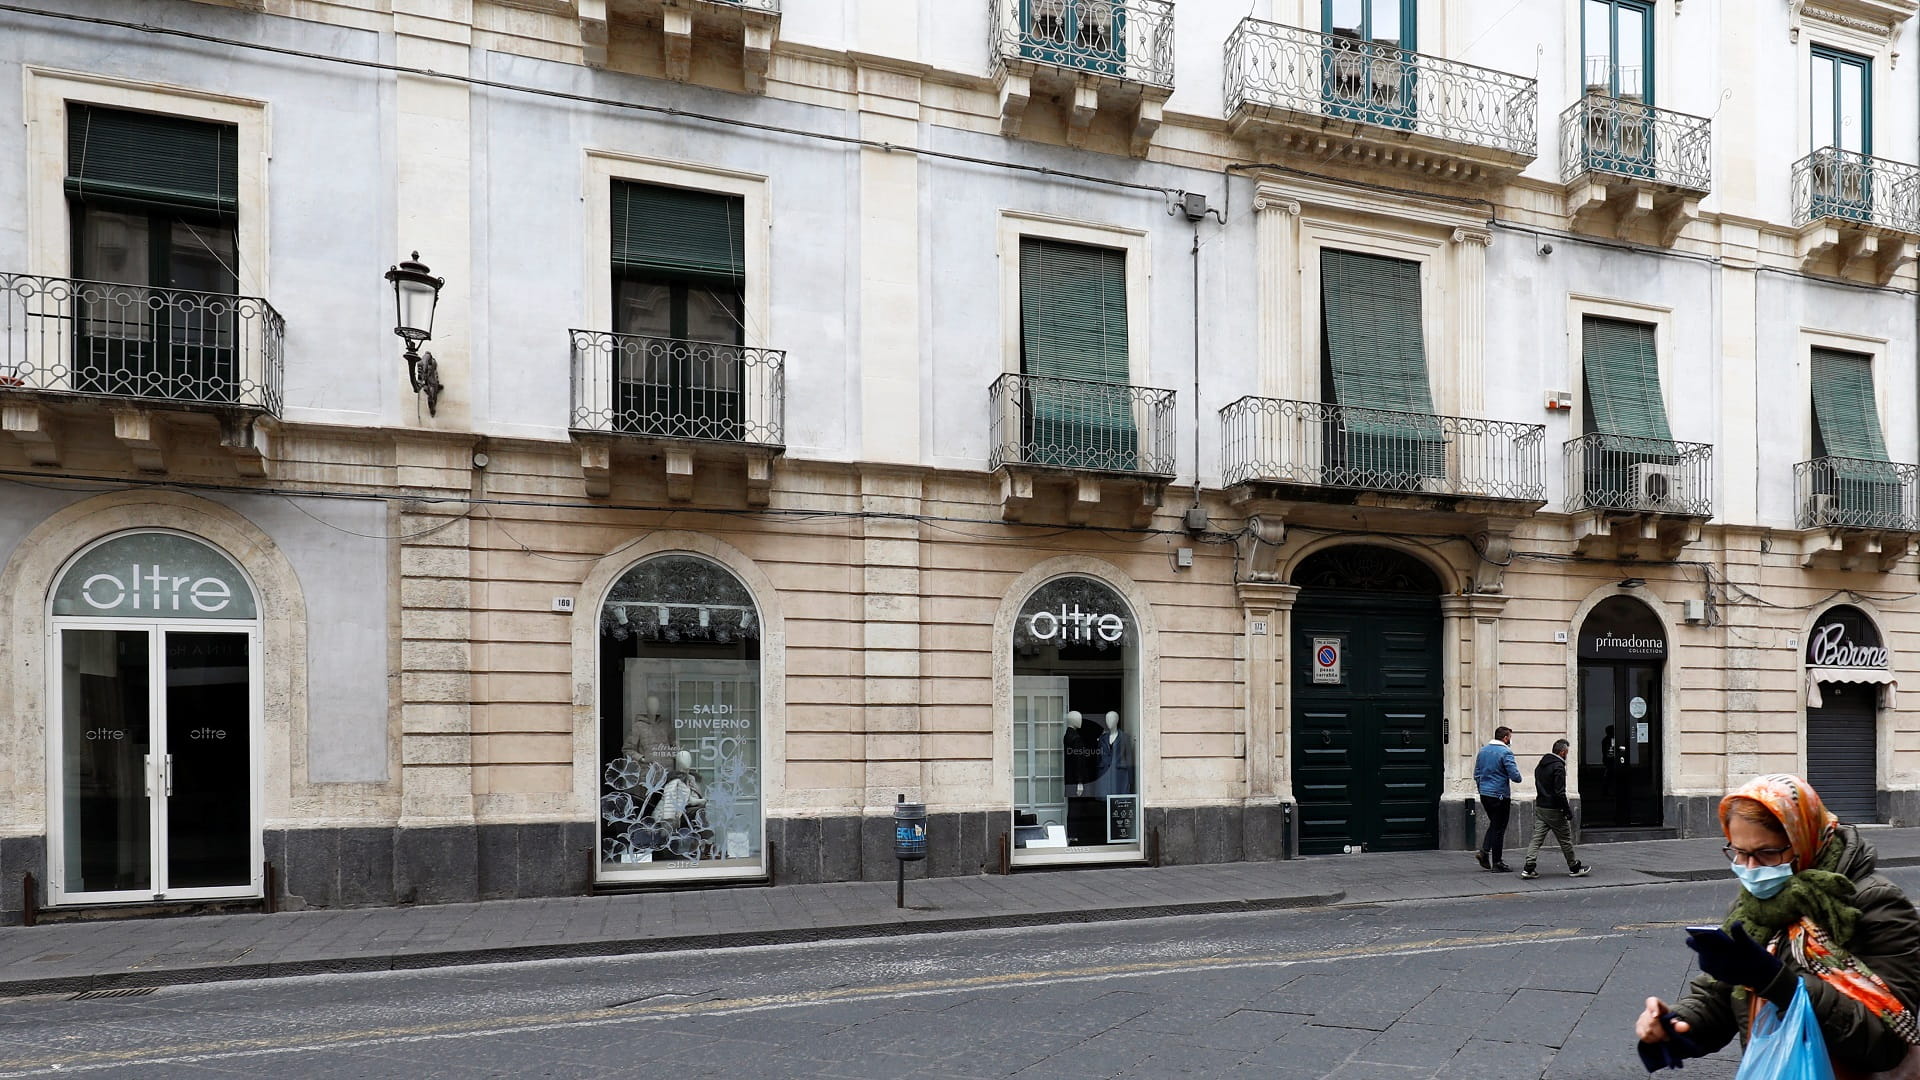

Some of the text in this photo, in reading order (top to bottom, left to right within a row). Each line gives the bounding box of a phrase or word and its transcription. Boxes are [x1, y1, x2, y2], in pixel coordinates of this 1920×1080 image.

[82, 564, 231, 612] oltre
[1031, 603, 1124, 641] oltre
[1596, 631, 1663, 653] primadonna
[1812, 623, 1888, 667] Barone
[693, 704, 733, 714] SALDI
[674, 719, 750, 729] D'INVERNO
[86, 728, 124, 740] oltre
[190, 728, 227, 740] oltre
